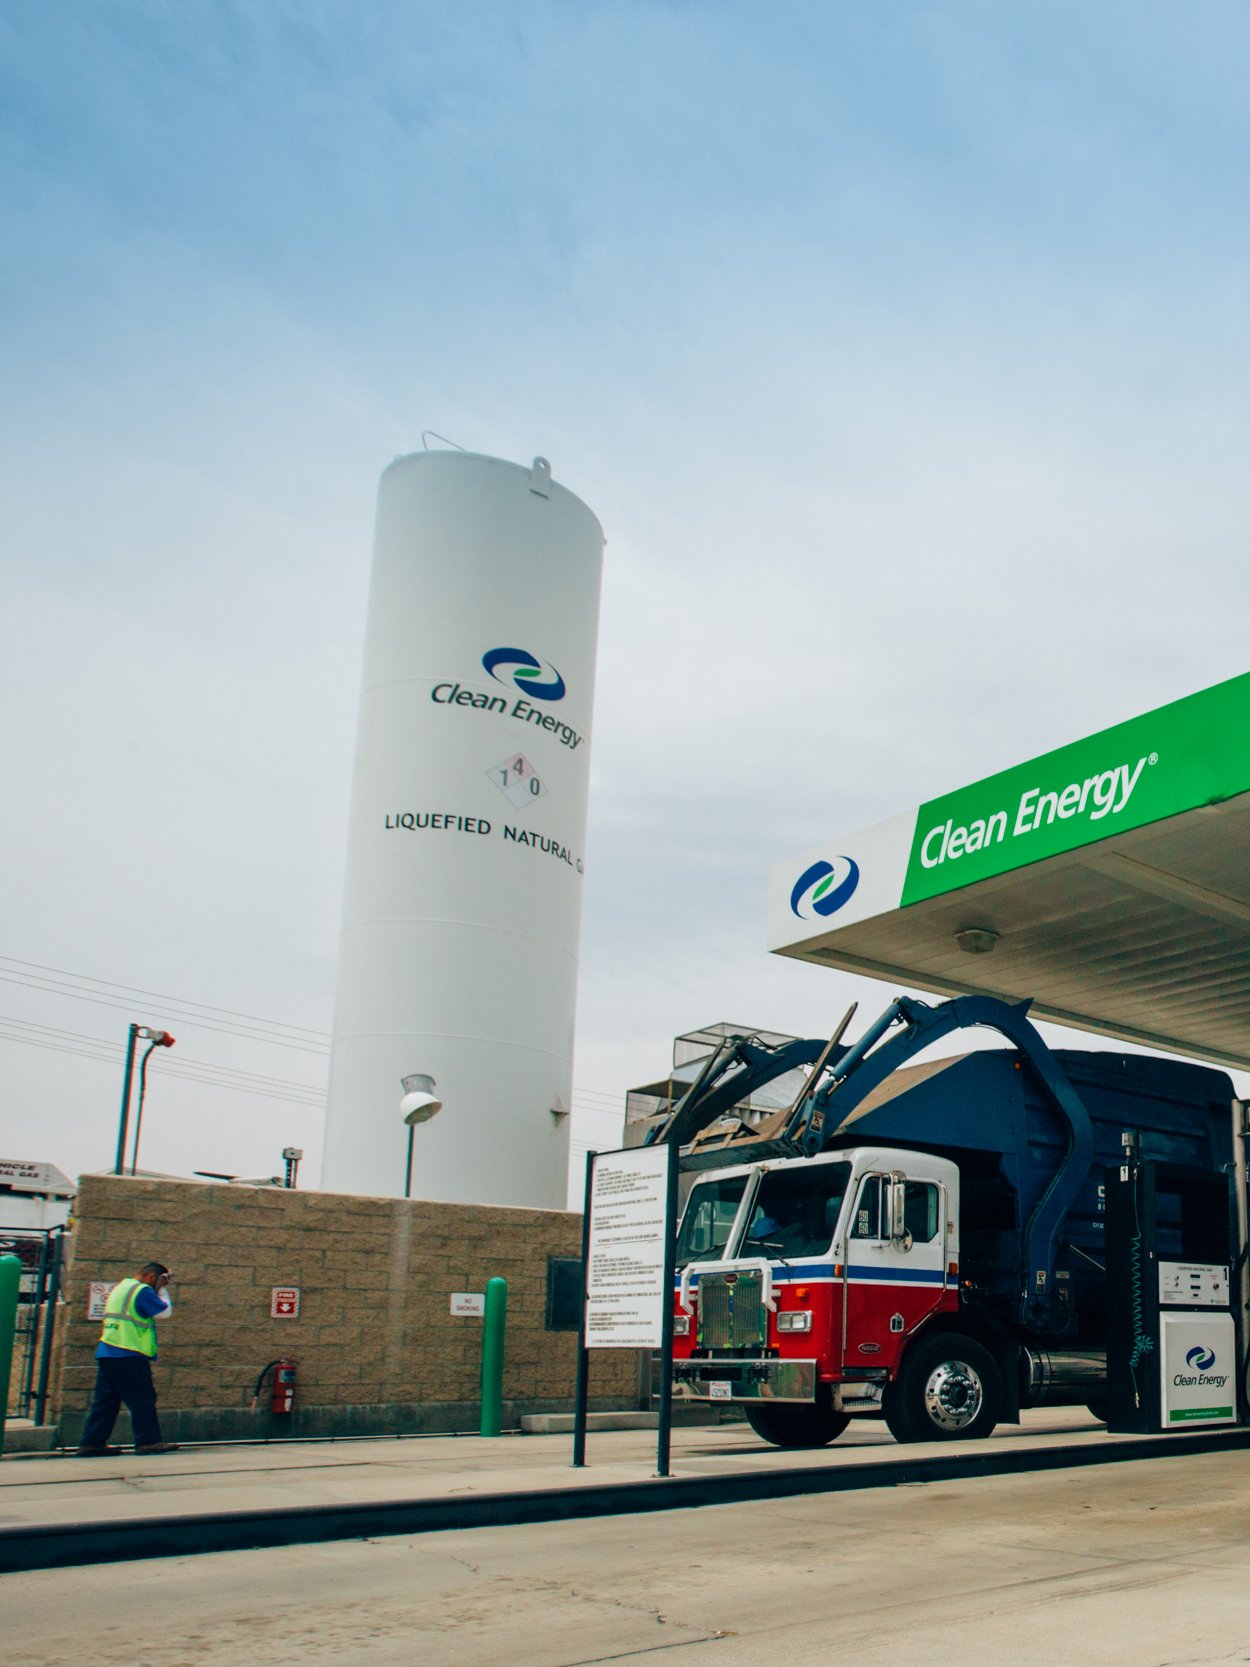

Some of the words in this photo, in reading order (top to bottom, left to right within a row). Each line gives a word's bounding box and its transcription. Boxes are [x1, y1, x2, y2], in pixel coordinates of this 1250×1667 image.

[431, 682, 507, 713] Clean
[510, 699, 582, 750] Energy
[513, 758, 524, 776] 4
[499, 769, 509, 787] 1
[529, 778, 541, 796] 0
[385, 812, 491, 835] LIQUEFIED
[503, 825, 573, 866] NATURAL
[920, 810, 1008, 869] Clean
[1223, 1267, 1228, 1281] 1
[1173, 1374, 1197, 1386] Clean
[1198, 1374, 1227, 1388] Energy
